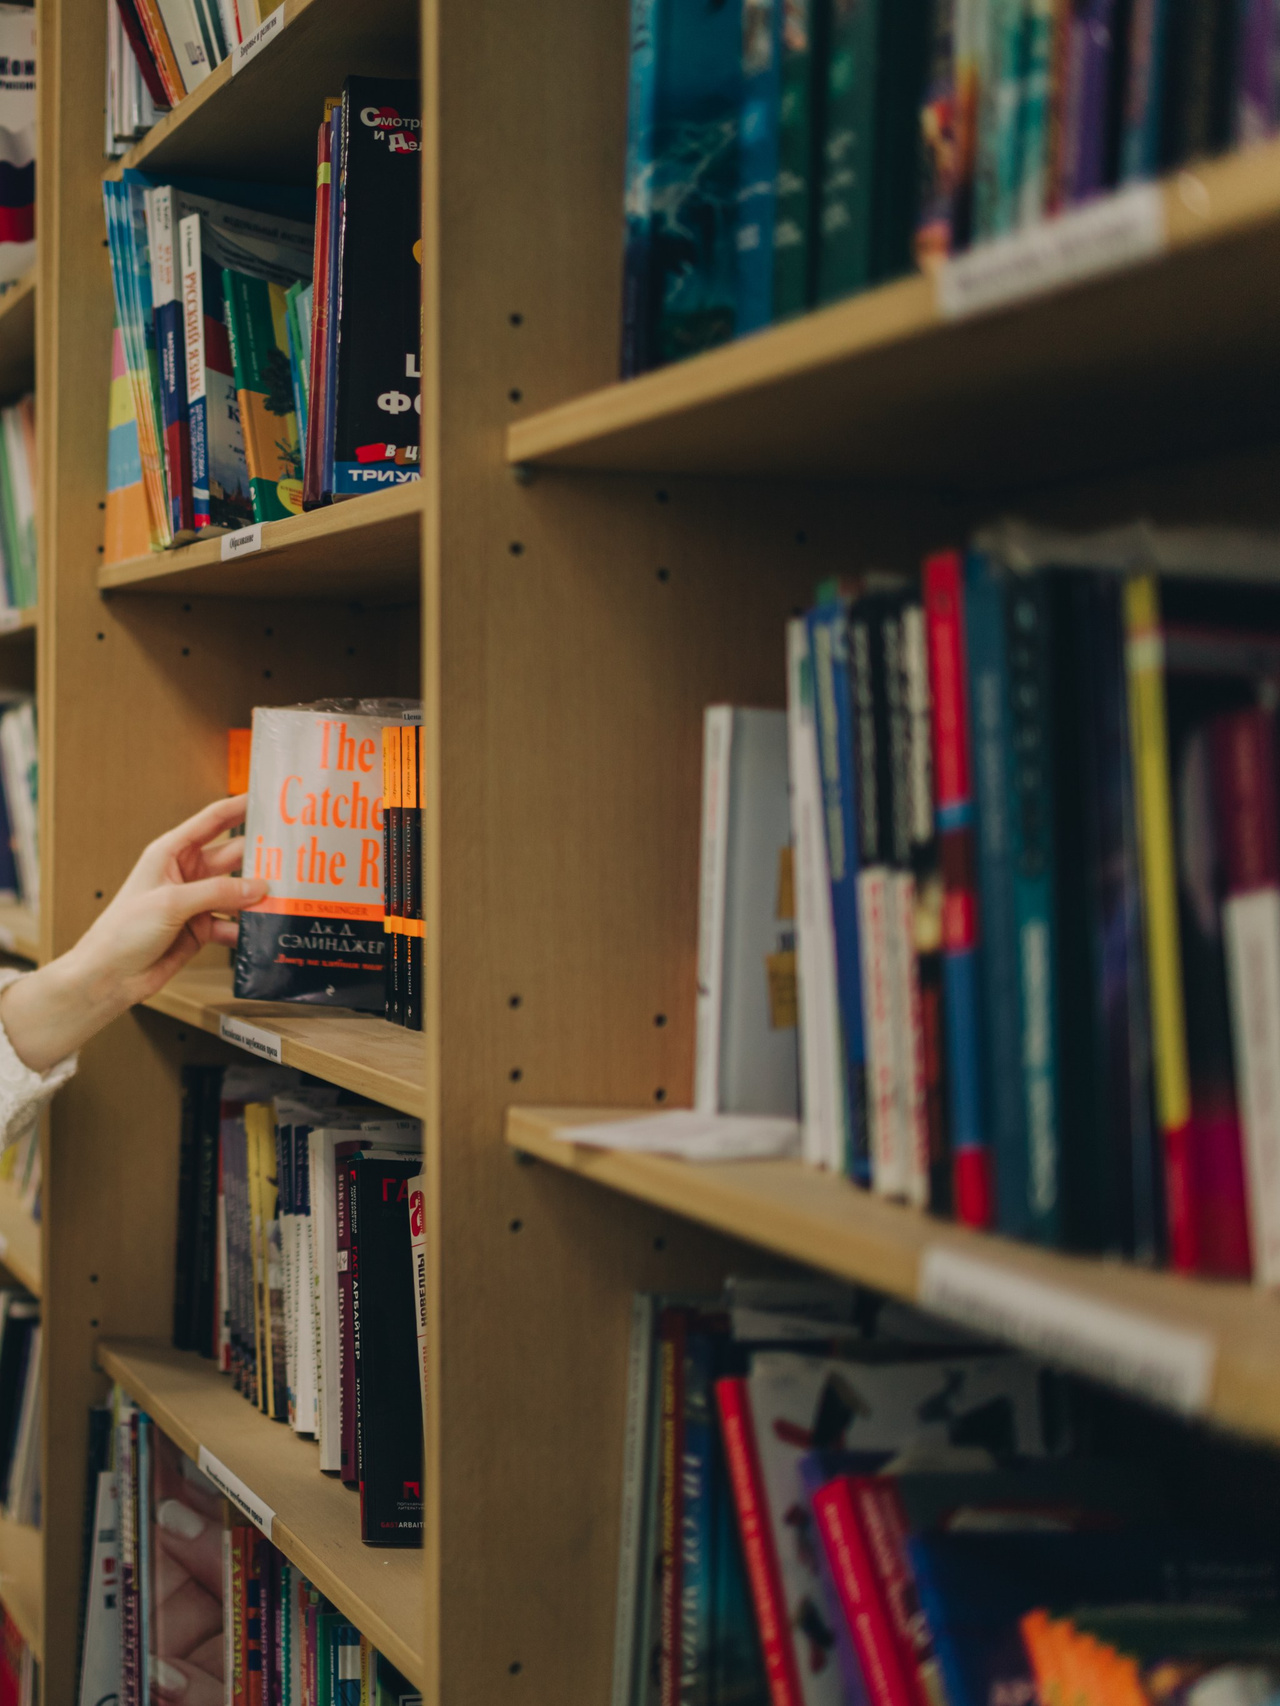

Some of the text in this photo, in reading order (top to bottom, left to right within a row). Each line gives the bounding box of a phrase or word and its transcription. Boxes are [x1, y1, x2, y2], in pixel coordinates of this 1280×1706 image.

[373, 131, 385, 141] и
[185, 271, 201, 346] РУССКИЙ
[188, 349, 201, 396] ЯЗЫК
[377, 390, 422, 415] Ф
[404, 446, 421, 461] ц
[229, 534, 254, 550] Образование
[316, 719, 376, 773] The
[254, 835, 384, 900] in the R
[317, 905, 369, 916] SALINGER
[278, 934, 385, 955] СЭЛИНДЖЕР
[352, 1245, 361, 1360] ГАСТАРБАЙТЕР
[417, 1253, 427, 1327] НОВЕЛЛЫ
[231, 1546, 244, 1695] ТАТУИРОВКА
